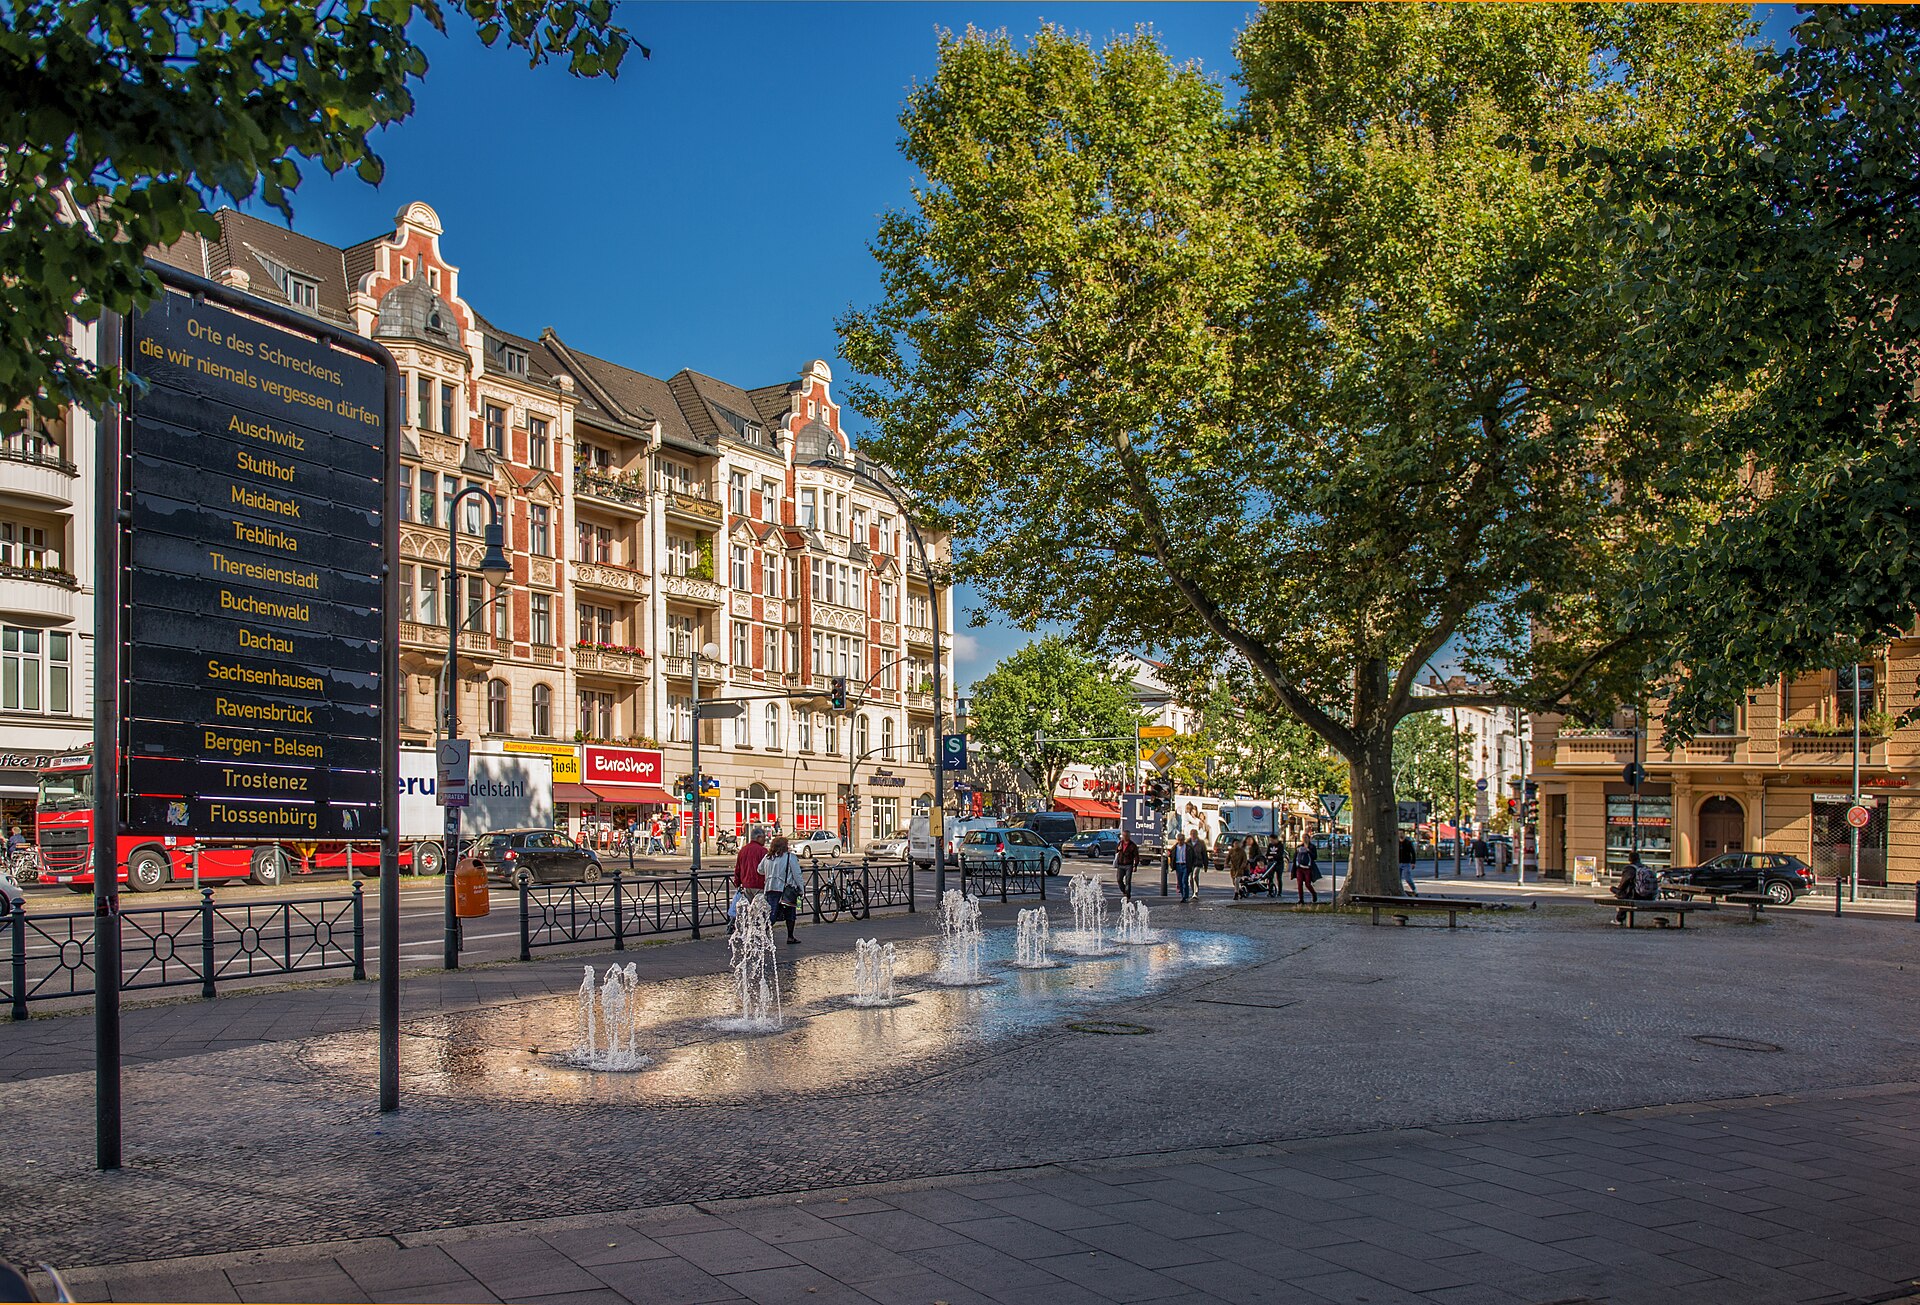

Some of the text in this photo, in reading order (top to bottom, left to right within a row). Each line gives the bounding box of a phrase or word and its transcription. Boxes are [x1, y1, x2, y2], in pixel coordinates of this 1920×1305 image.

[187, 319, 344, 387] Orte des Schreckens,
[139, 337, 380, 427] die wir niemals vergessen dürfen
[228, 415, 305, 451] Auschwitz
[237, 452, 295, 482] Stutthof
[231, 485, 301, 518] Maidanek
[233, 521, 298, 552] Treblinka
[210, 552, 319, 590] Theresienstadt
[220, 590, 310, 622] Buchenwald
[239, 629, 294, 653] Dachau
[208, 660, 323, 691] Sachsenhausen
[216, 697, 313, 724] Ravensbrück
[0, 753, 30, 767] ffee
[948, 737, 961, 753] S
[222, 768, 308, 791] Trostenez
[595, 755, 654, 777] EuroShop
[470, 780, 524, 797] delstahl
[210, 804, 318, 830] Flossenbürg
